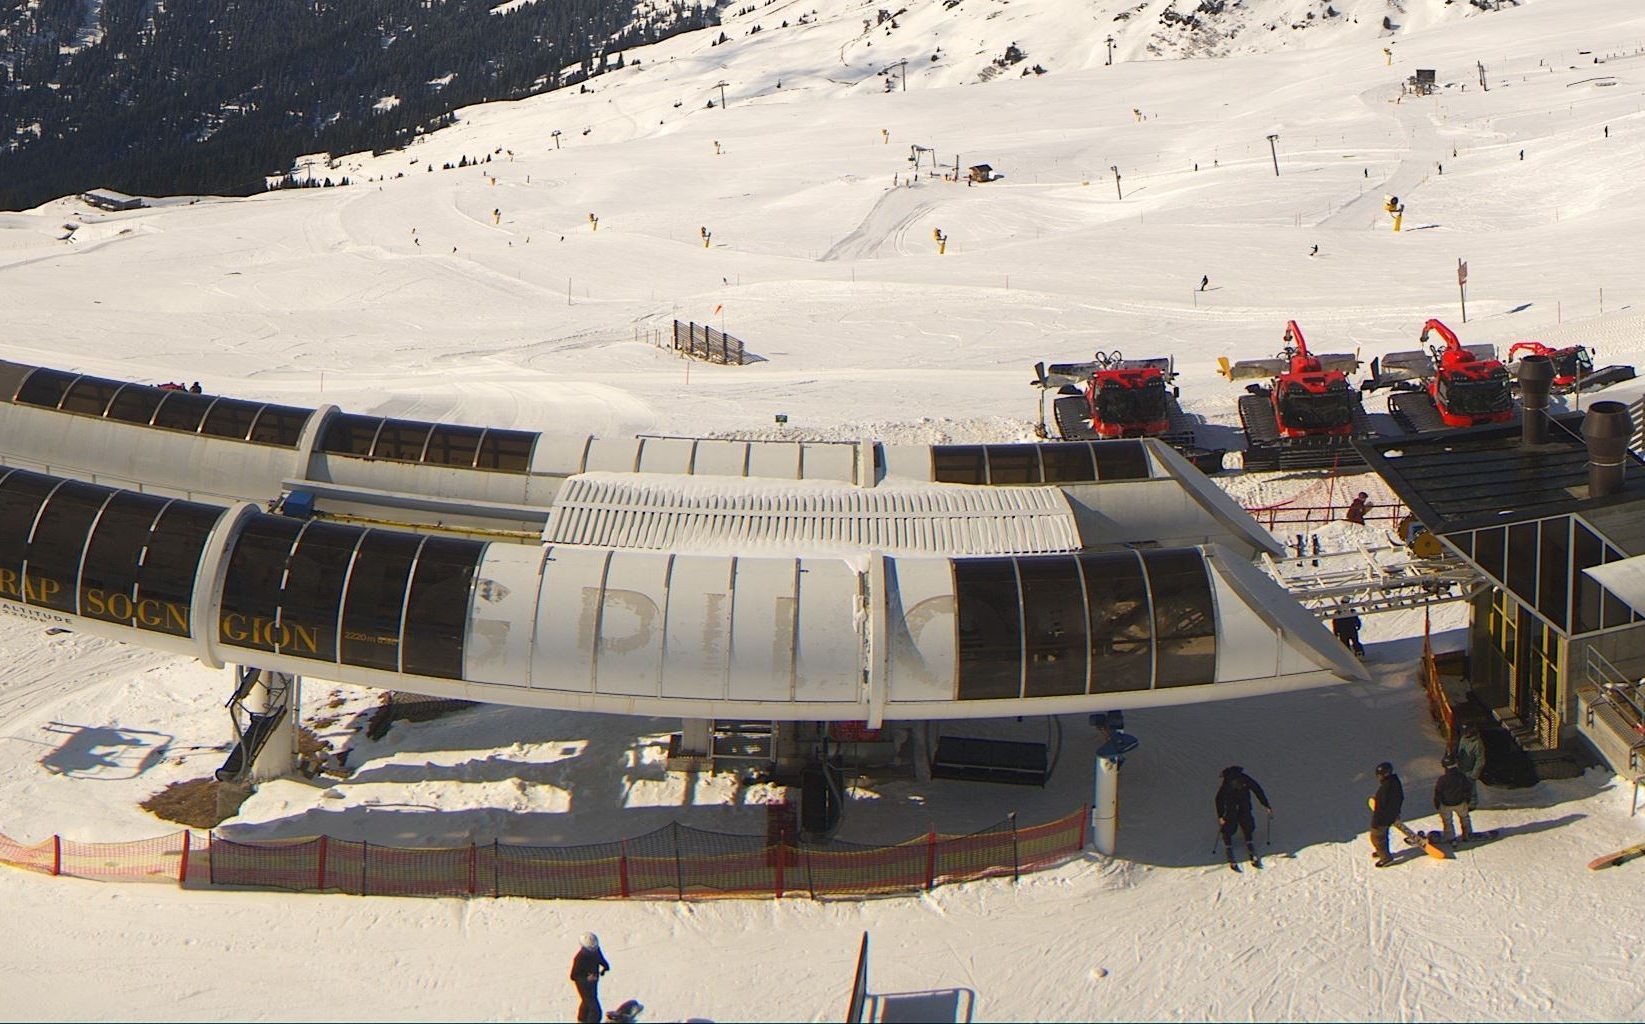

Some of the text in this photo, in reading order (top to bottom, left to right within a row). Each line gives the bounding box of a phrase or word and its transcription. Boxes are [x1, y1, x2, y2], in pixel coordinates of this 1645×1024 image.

[2, 603, 73, 624] ALTITUDE
[87, 587, 191, 633] SOGN
[223, 613, 319, 654] GION
